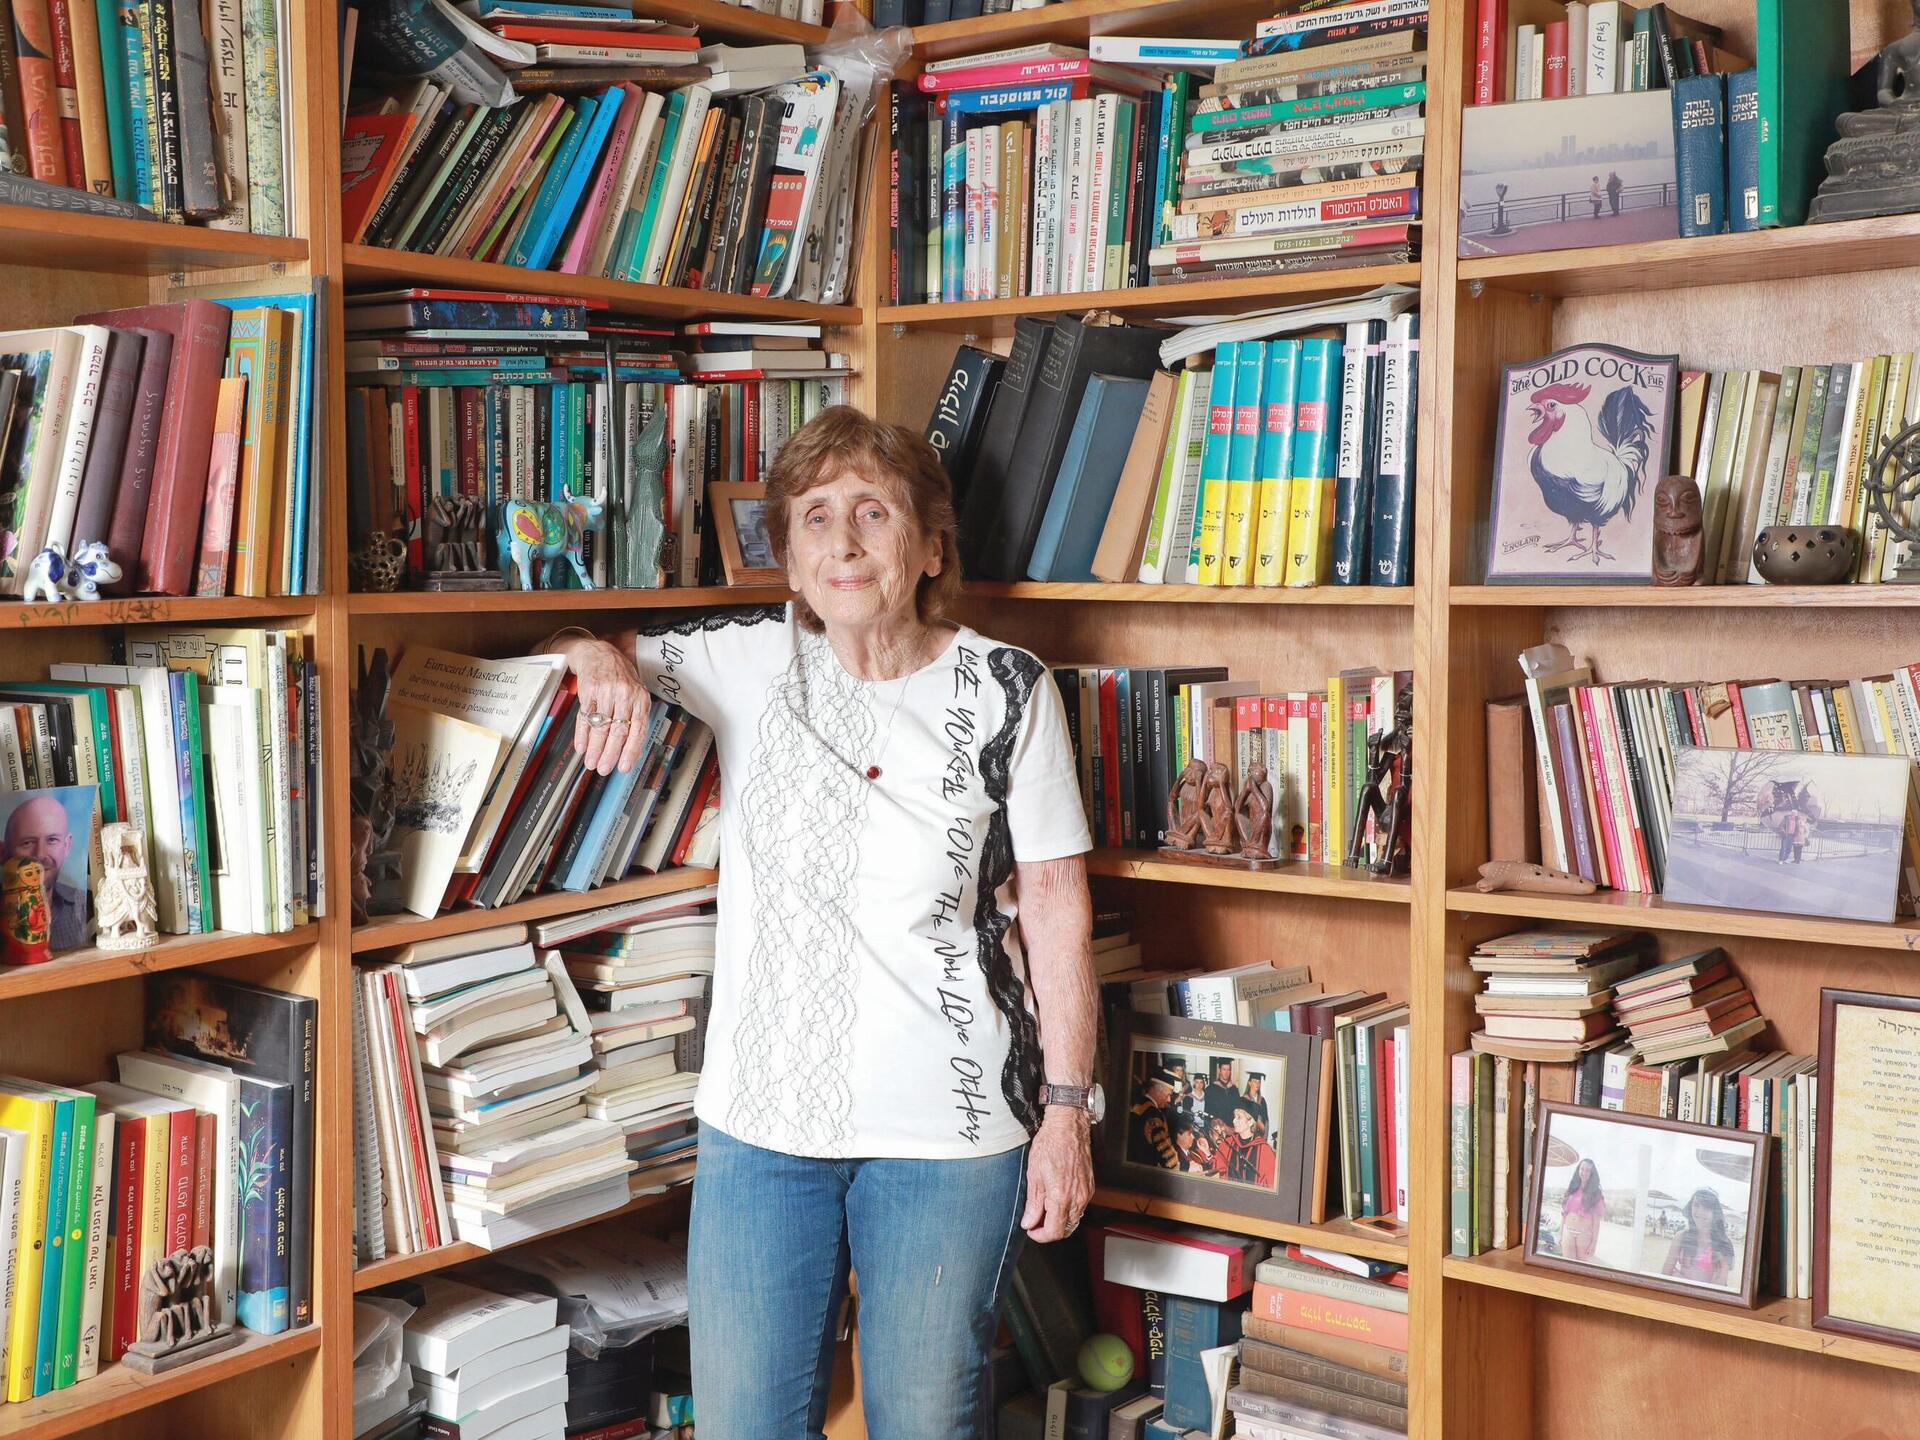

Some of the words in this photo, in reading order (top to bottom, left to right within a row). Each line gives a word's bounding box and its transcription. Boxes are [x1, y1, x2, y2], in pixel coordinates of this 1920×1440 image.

[1021, 63, 1055, 75] האריות
[1061, 61, 1080, 70] שער
[979, 89, 1041, 105] ממוסקבה
[1044, 86, 1068, 99] קול
[1098, 99, 1107, 119] אריה
[1685, 99, 1711, 110] תורה
[1681, 117, 1715, 128] כתובים
[1682, 109, 1714, 119] נביאים
[133, 118, 145, 162] בריאות
[1097, 121, 1106, 144] בראון
[1095, 151, 1103, 168] משה
[1211, 145, 1243, 162] סיפורי
[1245, 141, 1272, 157] בתים
[136, 168, 147, 195] הילד
[1071, 175, 1080, 200] צדק
[1095, 171, 1103, 187] דיין
[1091, 190, 1102, 223] במלחמת
[1325, 200, 1367, 216] ההיסטורי
[1369, 195, 1403, 211] האטלס
[1241, 212, 1274, 226] העולם
[1279, 204, 1316, 222] תולדות
[1069, 222, 1077, 234] אש
[1090, 225, 1098, 237] יום
[1087, 239, 1097, 272] הכיפורים
[87, 344, 103, 377] שמור
[82, 382, 95, 407] בלב
[65, 421, 89, 498] אנתולוגיה
[93, 1185, 105, 1205] אלף
[274, 1187, 286, 1216] להפליג
[91, 1210, 102, 1242] הפנים
[276, 1220, 285, 1234] עם
[88, 1246, 100, 1262] של
[276, 1238, 284, 1256] כוכב
[88, 1266, 99, 1290] האני
